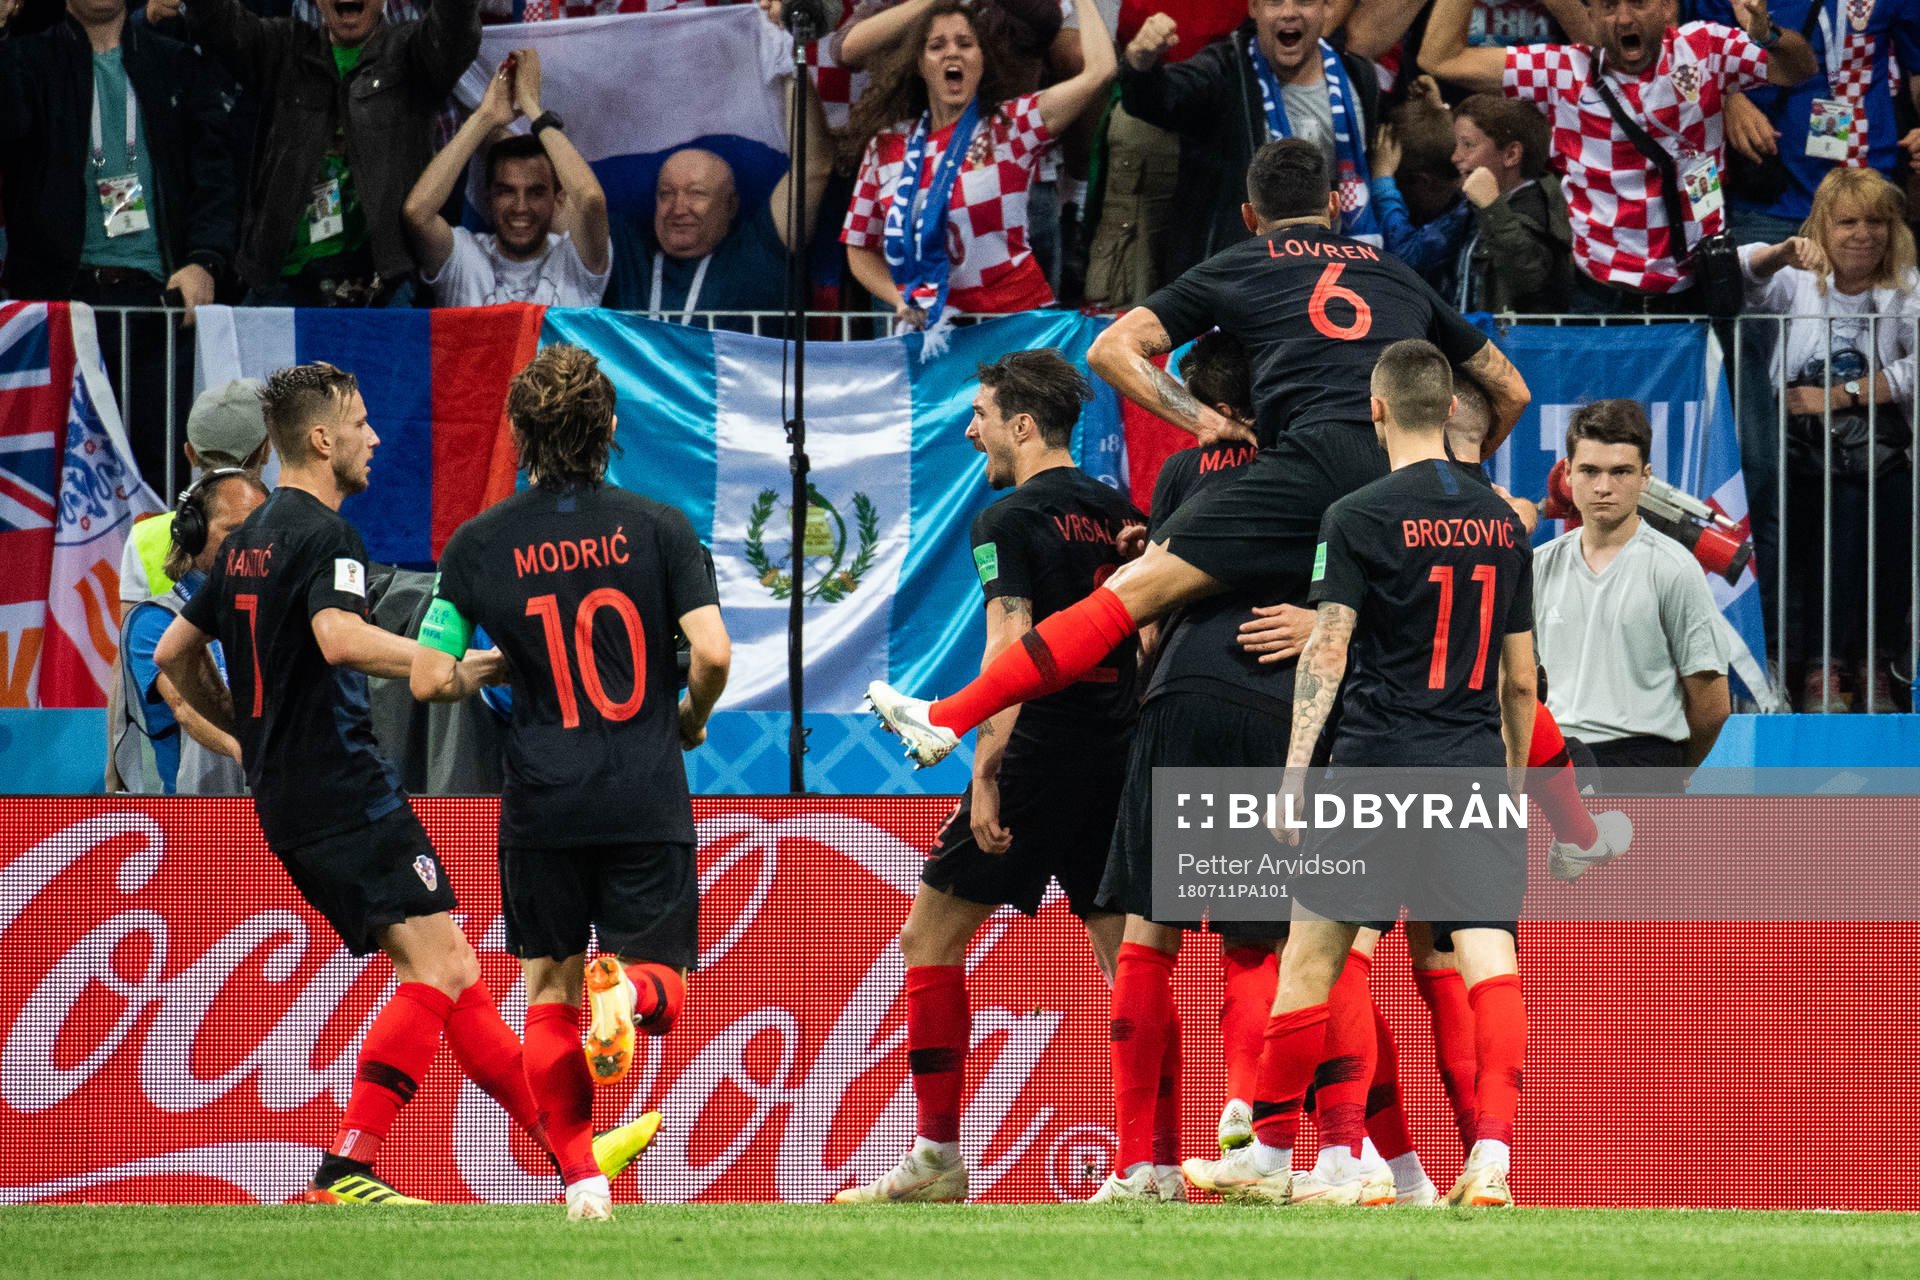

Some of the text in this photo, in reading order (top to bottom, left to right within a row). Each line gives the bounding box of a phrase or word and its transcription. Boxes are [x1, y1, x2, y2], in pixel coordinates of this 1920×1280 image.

[1267, 239, 1380, 262] LOVREN
[1308, 262, 1372, 340] 6
[513, 526, 630, 579] MODRIĆ
[1402, 517, 1515, 549] BROZOVIĆ
[525, 587, 647, 729] 10
[1428, 564, 1497, 690] 11
